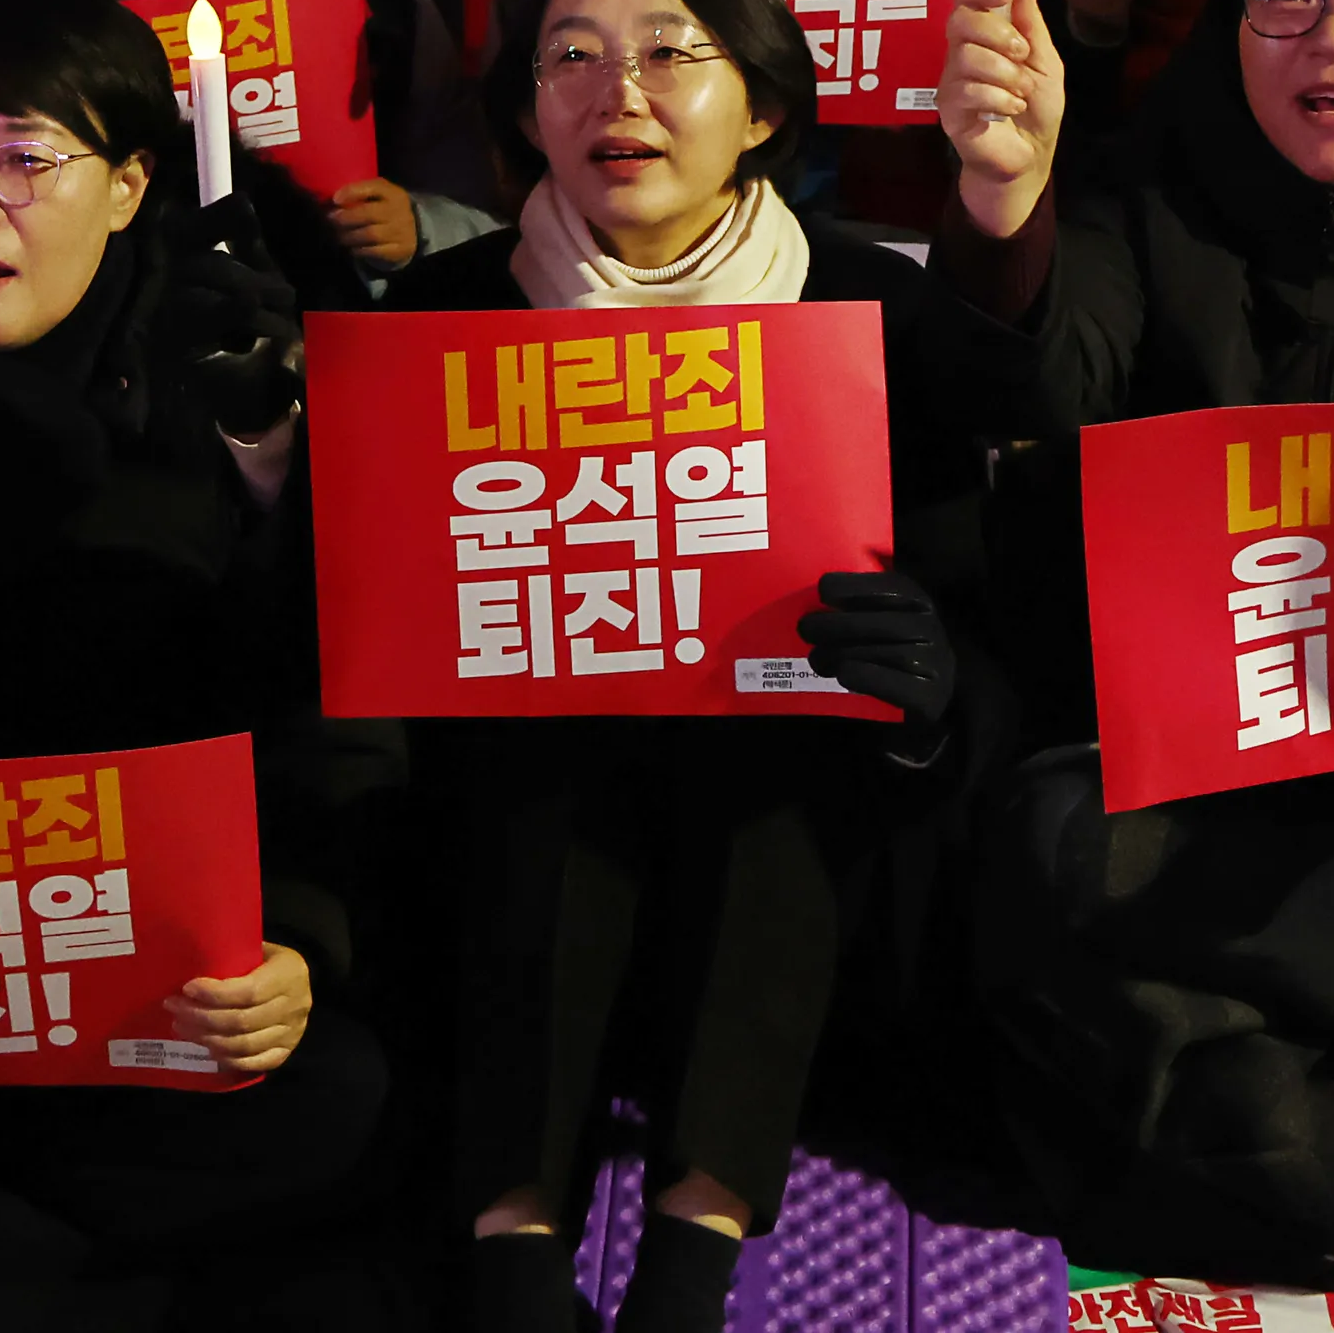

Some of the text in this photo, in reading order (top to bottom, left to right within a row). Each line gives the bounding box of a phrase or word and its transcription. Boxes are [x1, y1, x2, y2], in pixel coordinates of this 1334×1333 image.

[804, 27, 883, 96] 진!
[444, 321, 764, 452] 내란죄
[450, 440, 769, 572] 윤석열
[456, 567, 705, 678] 퇴진!
